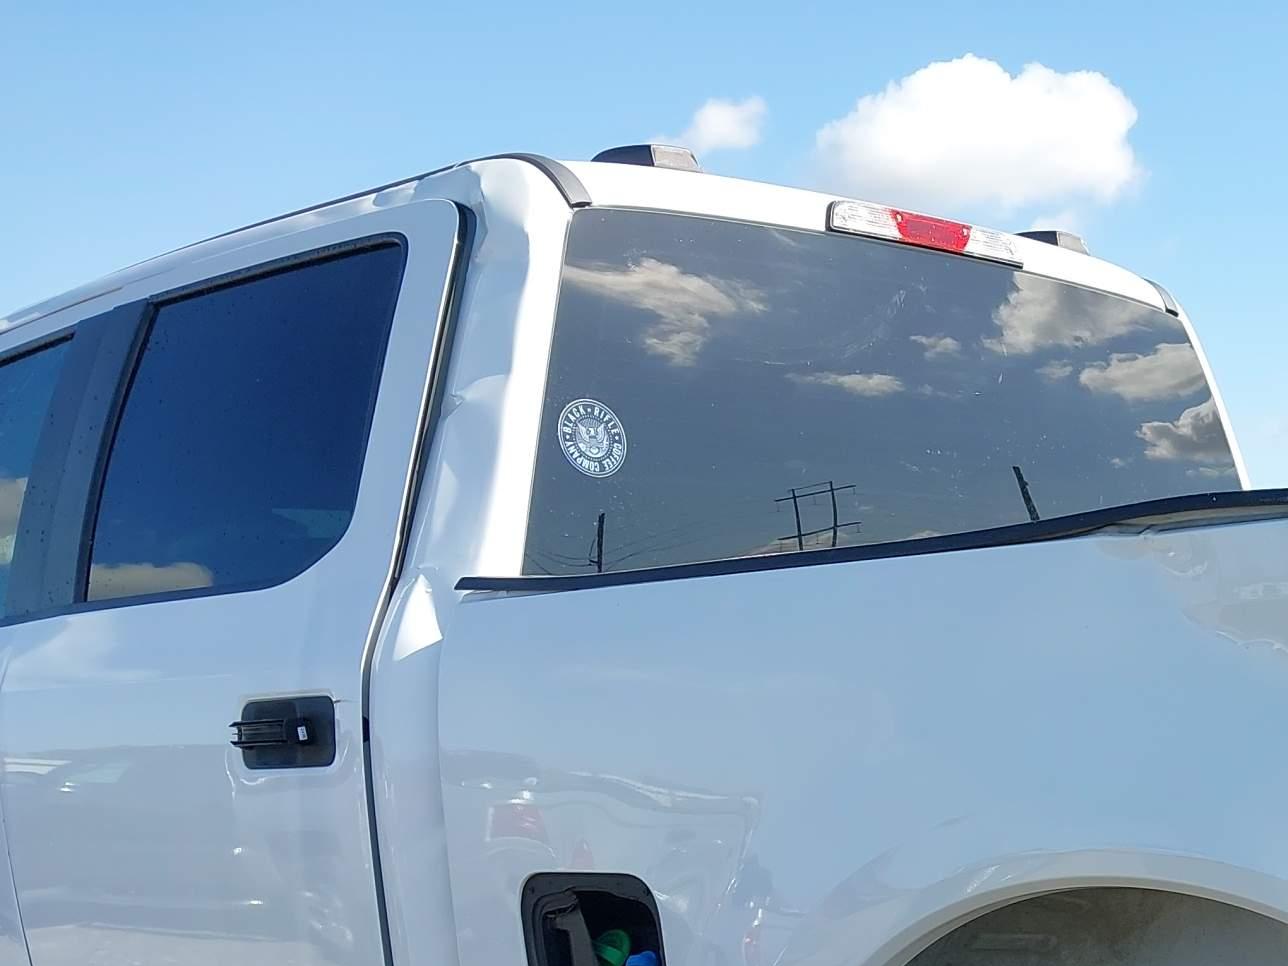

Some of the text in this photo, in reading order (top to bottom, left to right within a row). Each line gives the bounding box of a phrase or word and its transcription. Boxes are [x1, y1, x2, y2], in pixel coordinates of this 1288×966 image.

[563, 404, 622, 472] BLACK RIFLE COFFEE COMPANY
